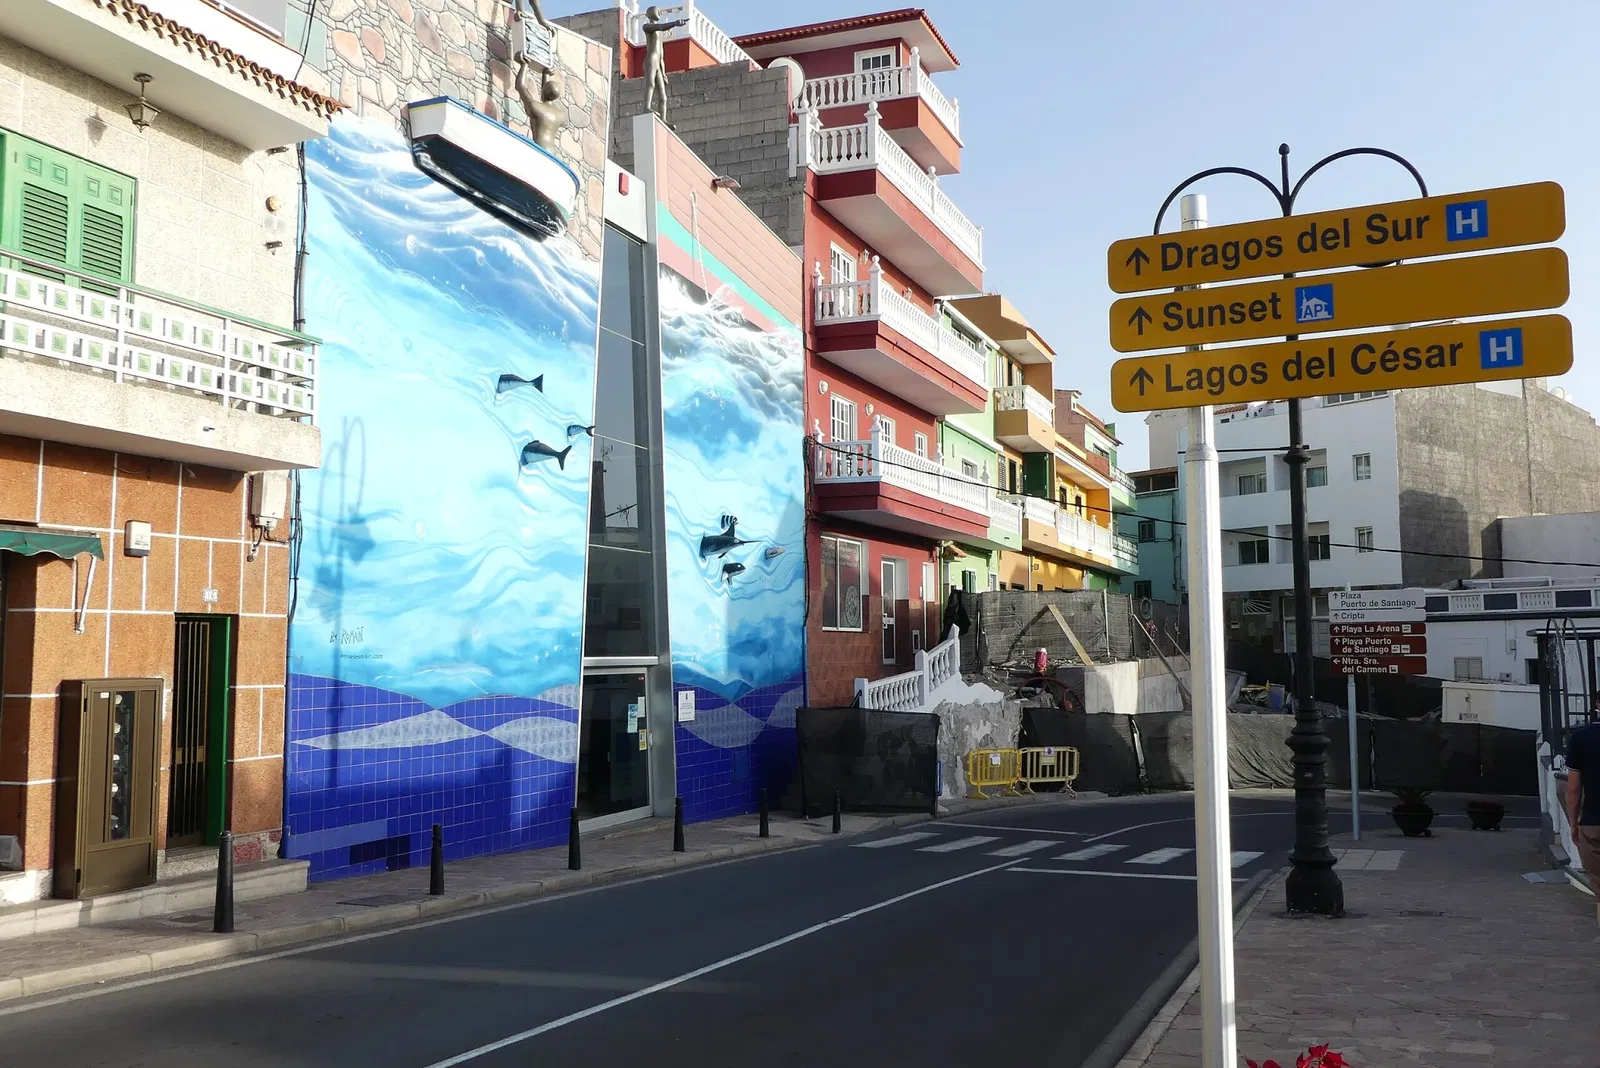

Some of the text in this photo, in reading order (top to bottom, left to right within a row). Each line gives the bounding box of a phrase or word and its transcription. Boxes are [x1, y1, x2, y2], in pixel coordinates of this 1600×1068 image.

[1160, 234, 1284, 271] Dragos
[1297, 218, 1350, 254] del
[1365, 213, 1430, 245] Sur
[1162, 291, 1282, 332] Sunset
[1164, 360, 1269, 397] Lagos
[1281, 347, 1336, 382] del
[1350, 340, 1464, 376] César
[1340, 592, 1361, 600] Plaza
[1341, 598, 1416, 608] Puerto de Santiago
[1341, 612, 1365, 621] Cripta
[1341, 625, 1362, 634] Playa
[1376, 624, 1400, 632] Arena
[1342, 637, 1392, 646] Playa Puerto
[1354, 646, 1389, 655] Santiago
[1342, 657, 1380, 665] Ntra. Sra.
[1342, 665, 1388, 673] del Carmen
